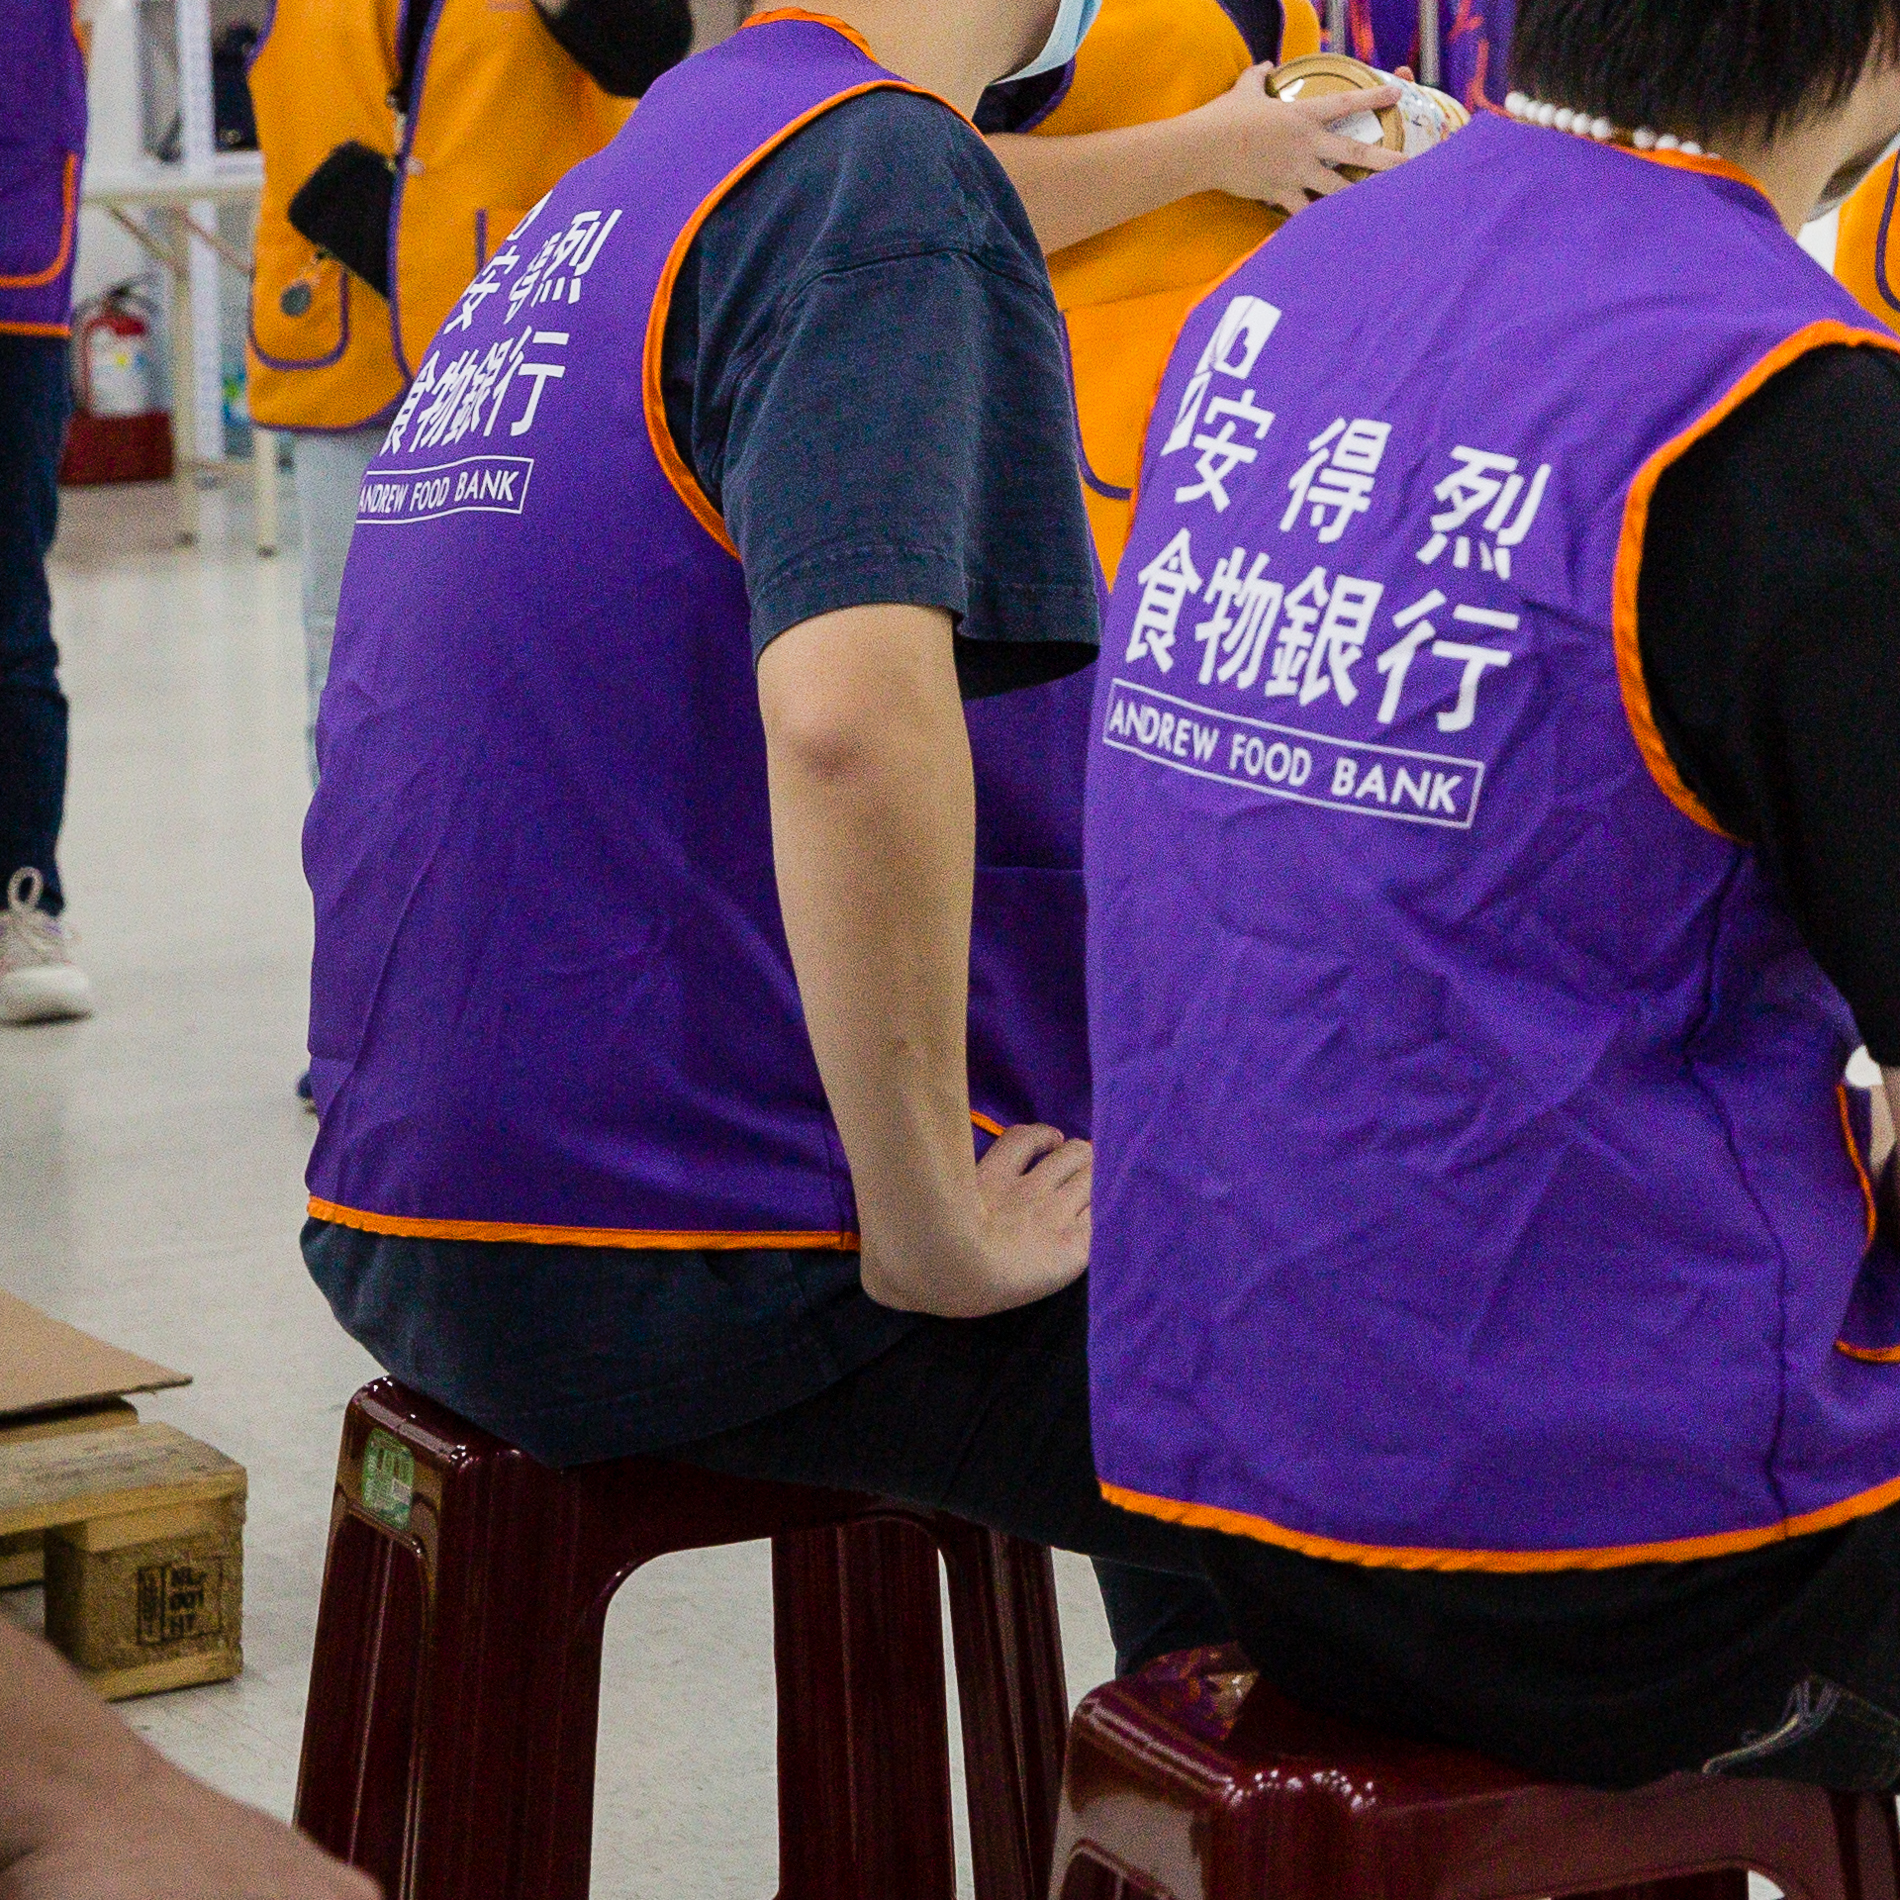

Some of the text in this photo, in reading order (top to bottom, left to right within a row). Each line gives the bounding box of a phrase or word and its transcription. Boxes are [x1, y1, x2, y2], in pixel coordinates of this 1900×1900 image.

[359, 470, 519, 514] ANDREW FOOD BANK
[1176, 390, 1551, 580] 安得烈
[1125, 528, 1519, 732] 食物銀行
[1109, 699, 1463, 813] ANDREW FOOD BANK
